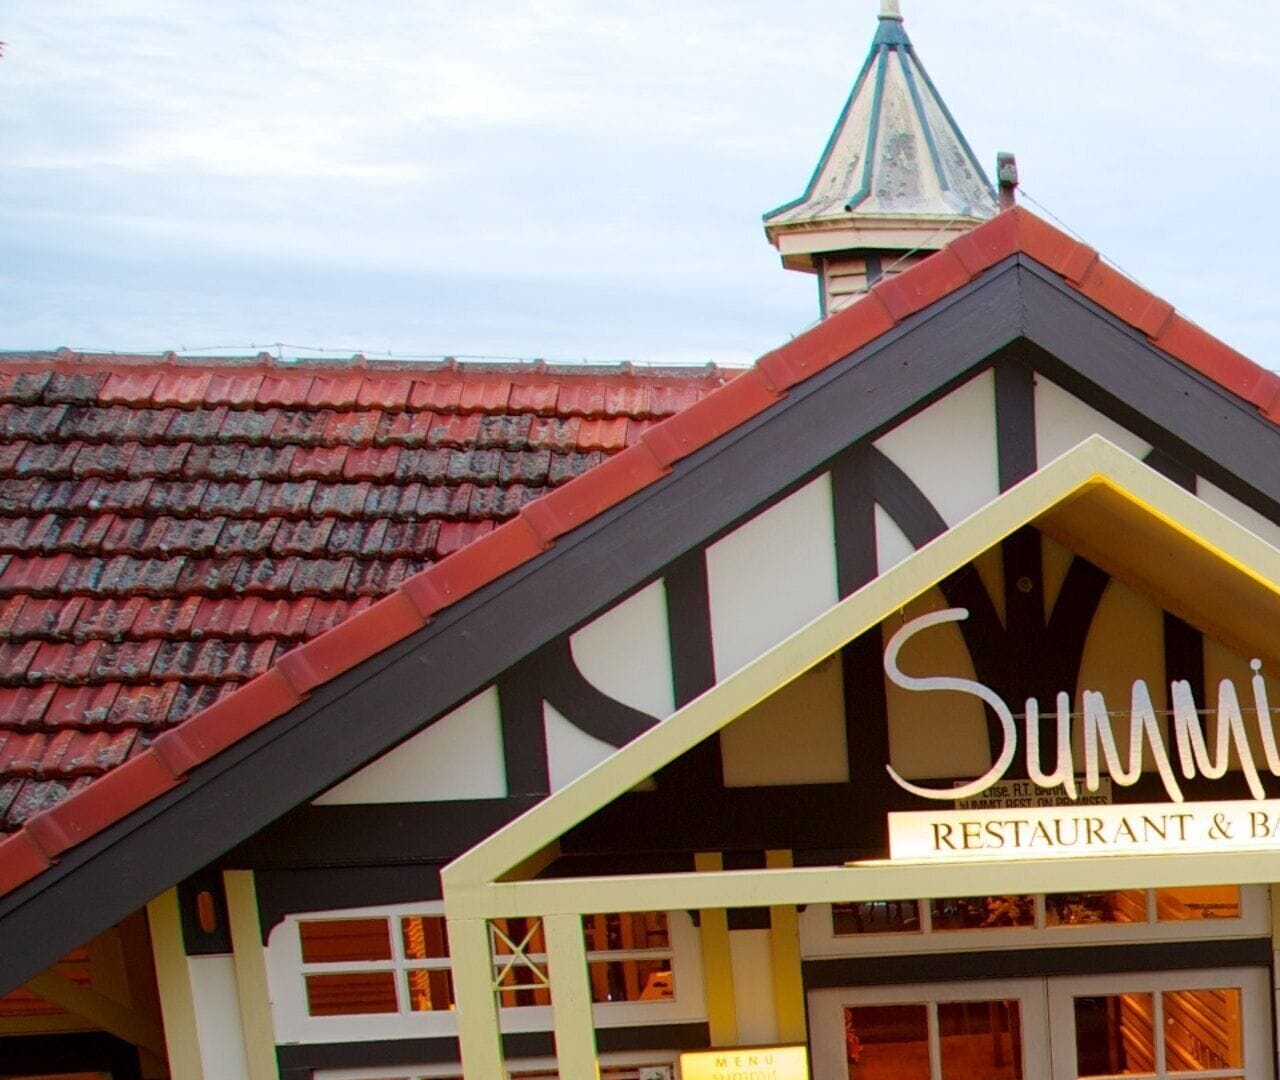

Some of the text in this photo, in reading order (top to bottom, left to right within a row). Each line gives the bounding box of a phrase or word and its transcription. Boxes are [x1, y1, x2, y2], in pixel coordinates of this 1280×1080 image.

[931, 813, 1194, 850] RESTAURANT
[1207, 812, 1234, 840] &
[715, 1055, 773, 1068] MENU
